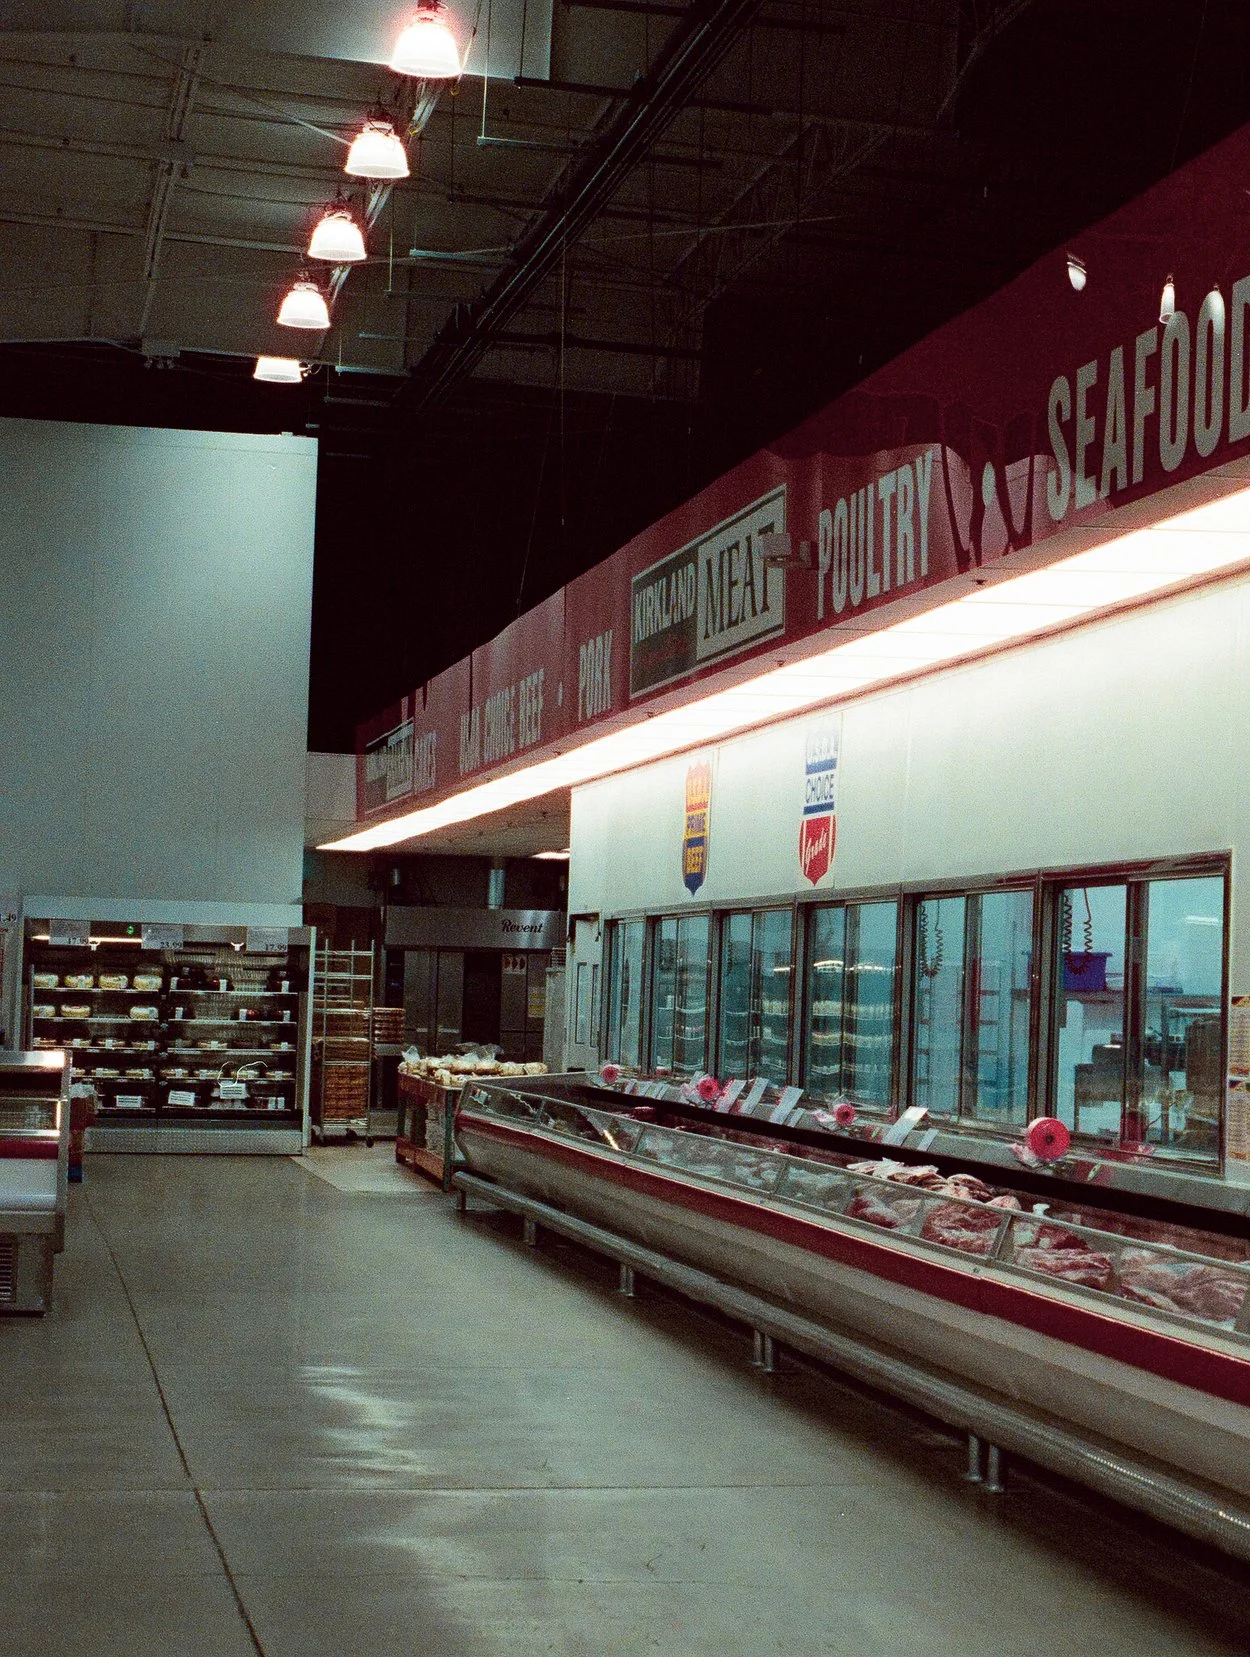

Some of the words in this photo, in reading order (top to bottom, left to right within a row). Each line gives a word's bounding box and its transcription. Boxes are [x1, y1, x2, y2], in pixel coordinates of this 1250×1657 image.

[817, 450, 935, 620] POULTRY
[633, 562, 697, 645] KIRKLAND
[703, 522, 777, 641] MEAT
[518, 669, 545, 748] BEEF
[578, 629, 614, 723] PORK
[805, 774, 835, 804] CHOICE
[500, 918, 544, 934] Revent
